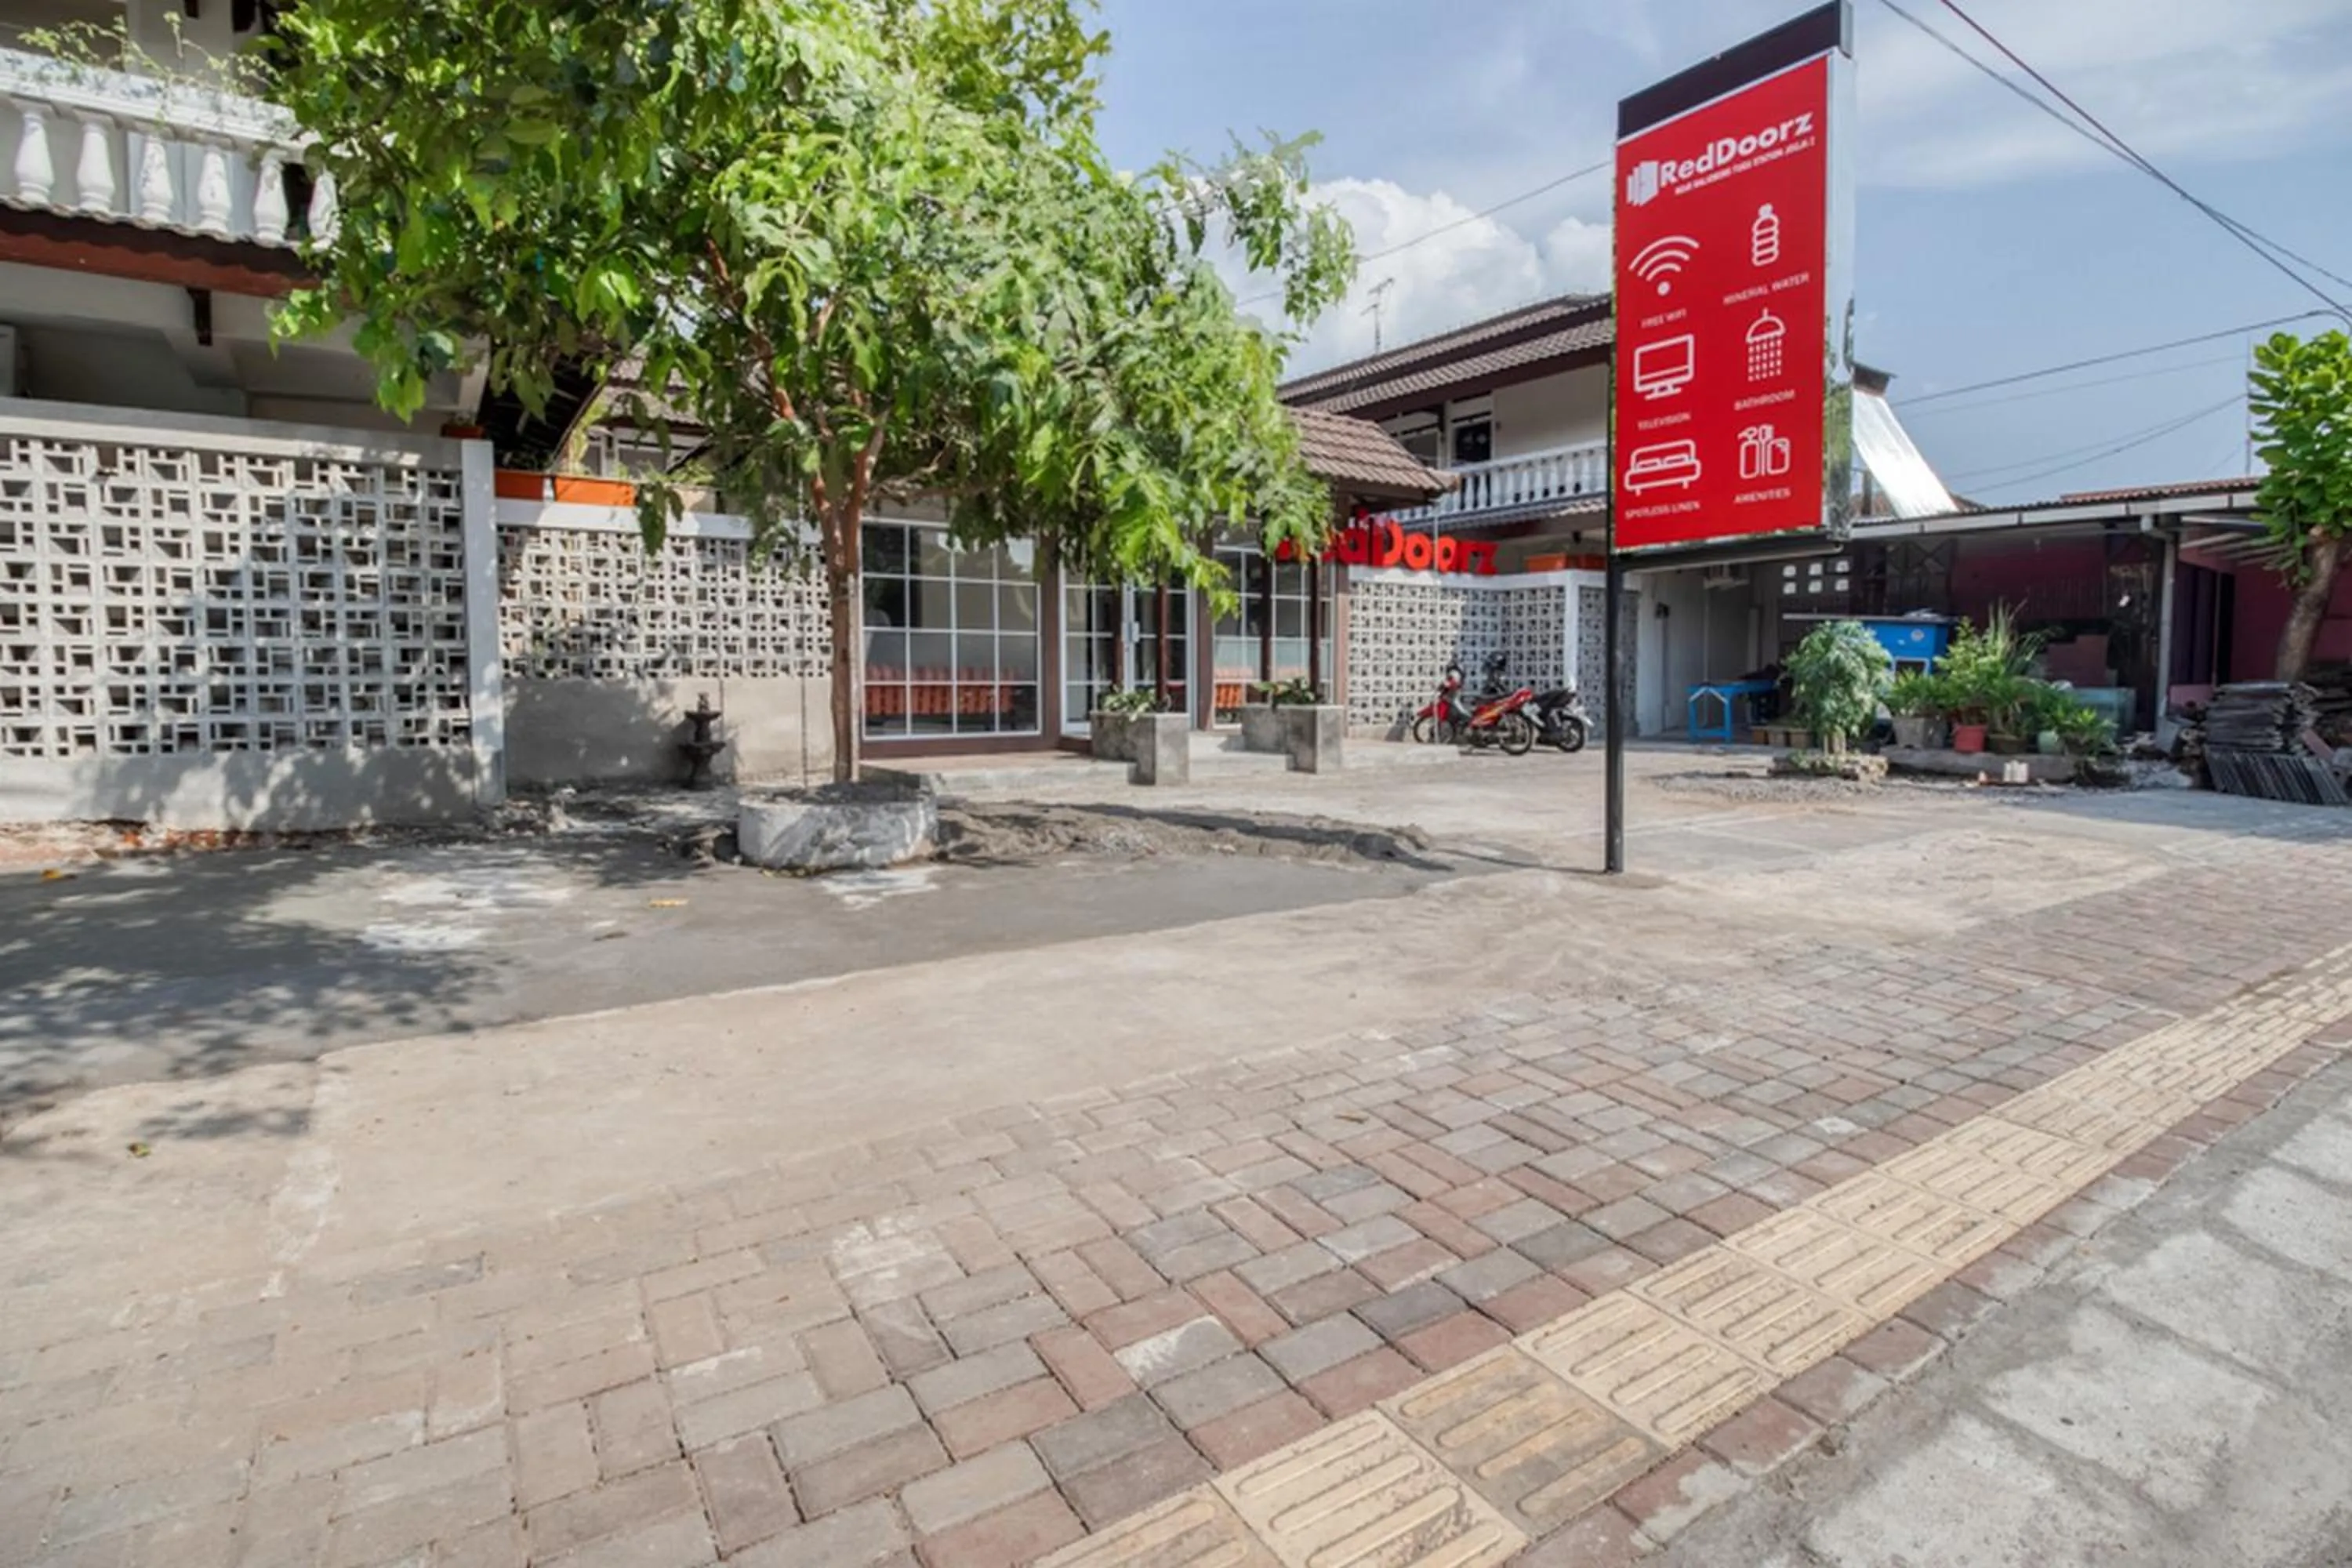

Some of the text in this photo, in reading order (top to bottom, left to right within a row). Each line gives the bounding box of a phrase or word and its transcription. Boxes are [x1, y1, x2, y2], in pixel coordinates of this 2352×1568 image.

[1661, 111, 1813, 187] RedDoorz
[1723, 271, 1810, 306] MINERAL WATER
[1734, 389, 1795, 412] BATHROOM
[1638, 412, 1691, 430] TELEVISION
[1733, 486, 1791, 504] AMENITIES
[1276, 508, 1500, 575] dDoorz
